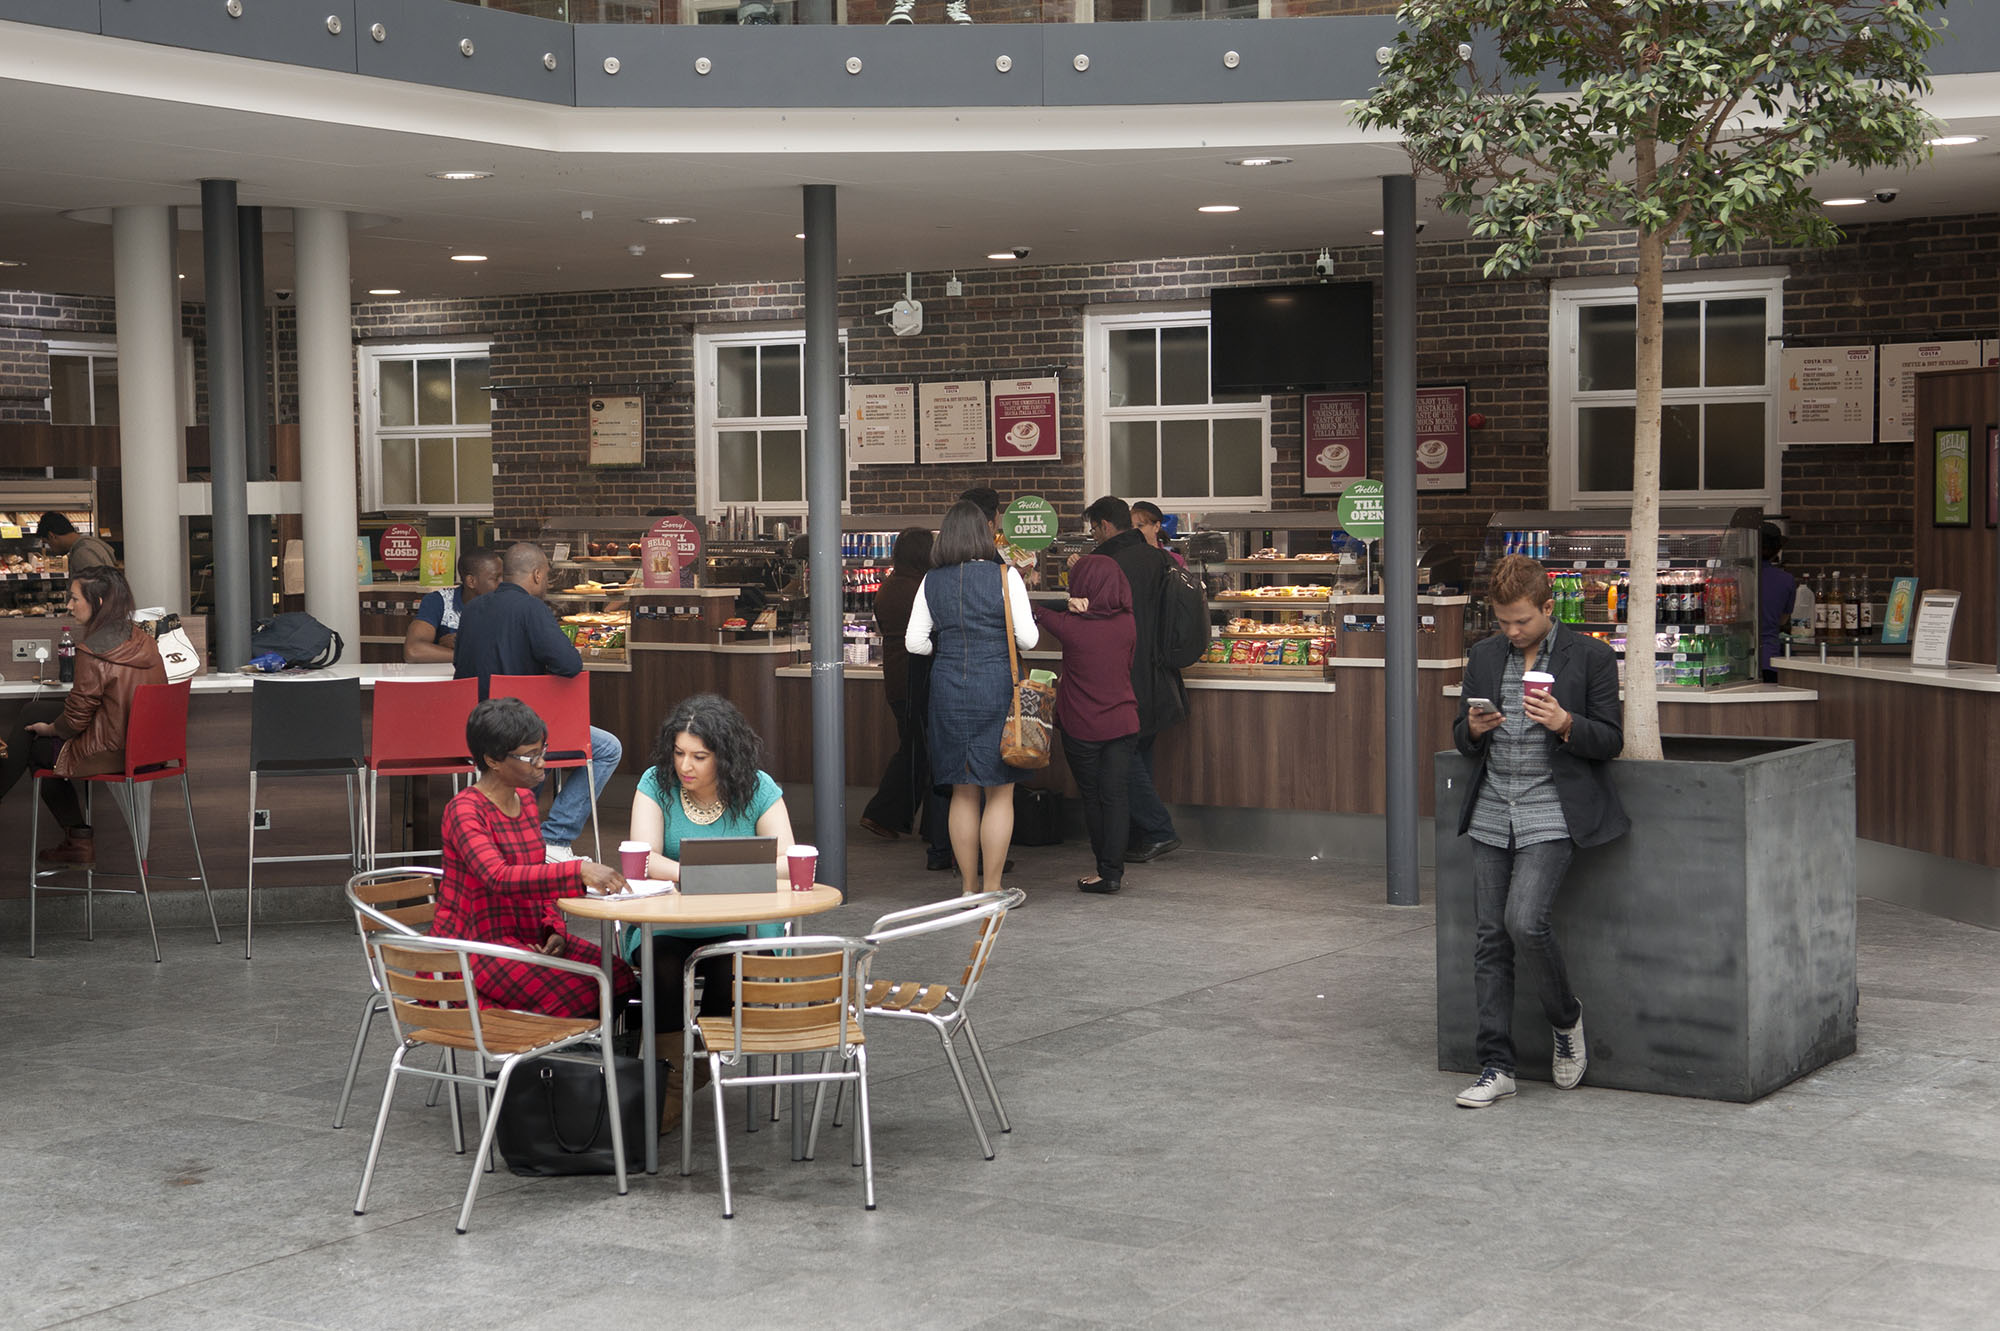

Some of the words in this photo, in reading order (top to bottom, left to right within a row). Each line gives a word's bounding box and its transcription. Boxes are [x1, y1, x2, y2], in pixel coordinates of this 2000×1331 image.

[1416, 404, 1457, 412] MISTAKABLE
[1940, 433, 1966, 452] HELLO
[1354, 485, 1383, 494] Hello!
[1017, 500, 1044, 509] Hello!
[1354, 500, 1383, 510] TILL
[1017, 515, 1043, 524] TILL
[1350, 510, 1384, 520] OPEN
[661, 520, 687, 530] Sorry!
[1014, 525, 1047, 534] OPEN
[391, 527, 412, 536] Sorry!
[391, 540, 411, 548] TILL
[426, 539, 450, 548] HELLO
[647, 539, 672, 549] HELLO
[677, 543, 695, 551] SED
[384, 549, 418, 557] CLOSED
